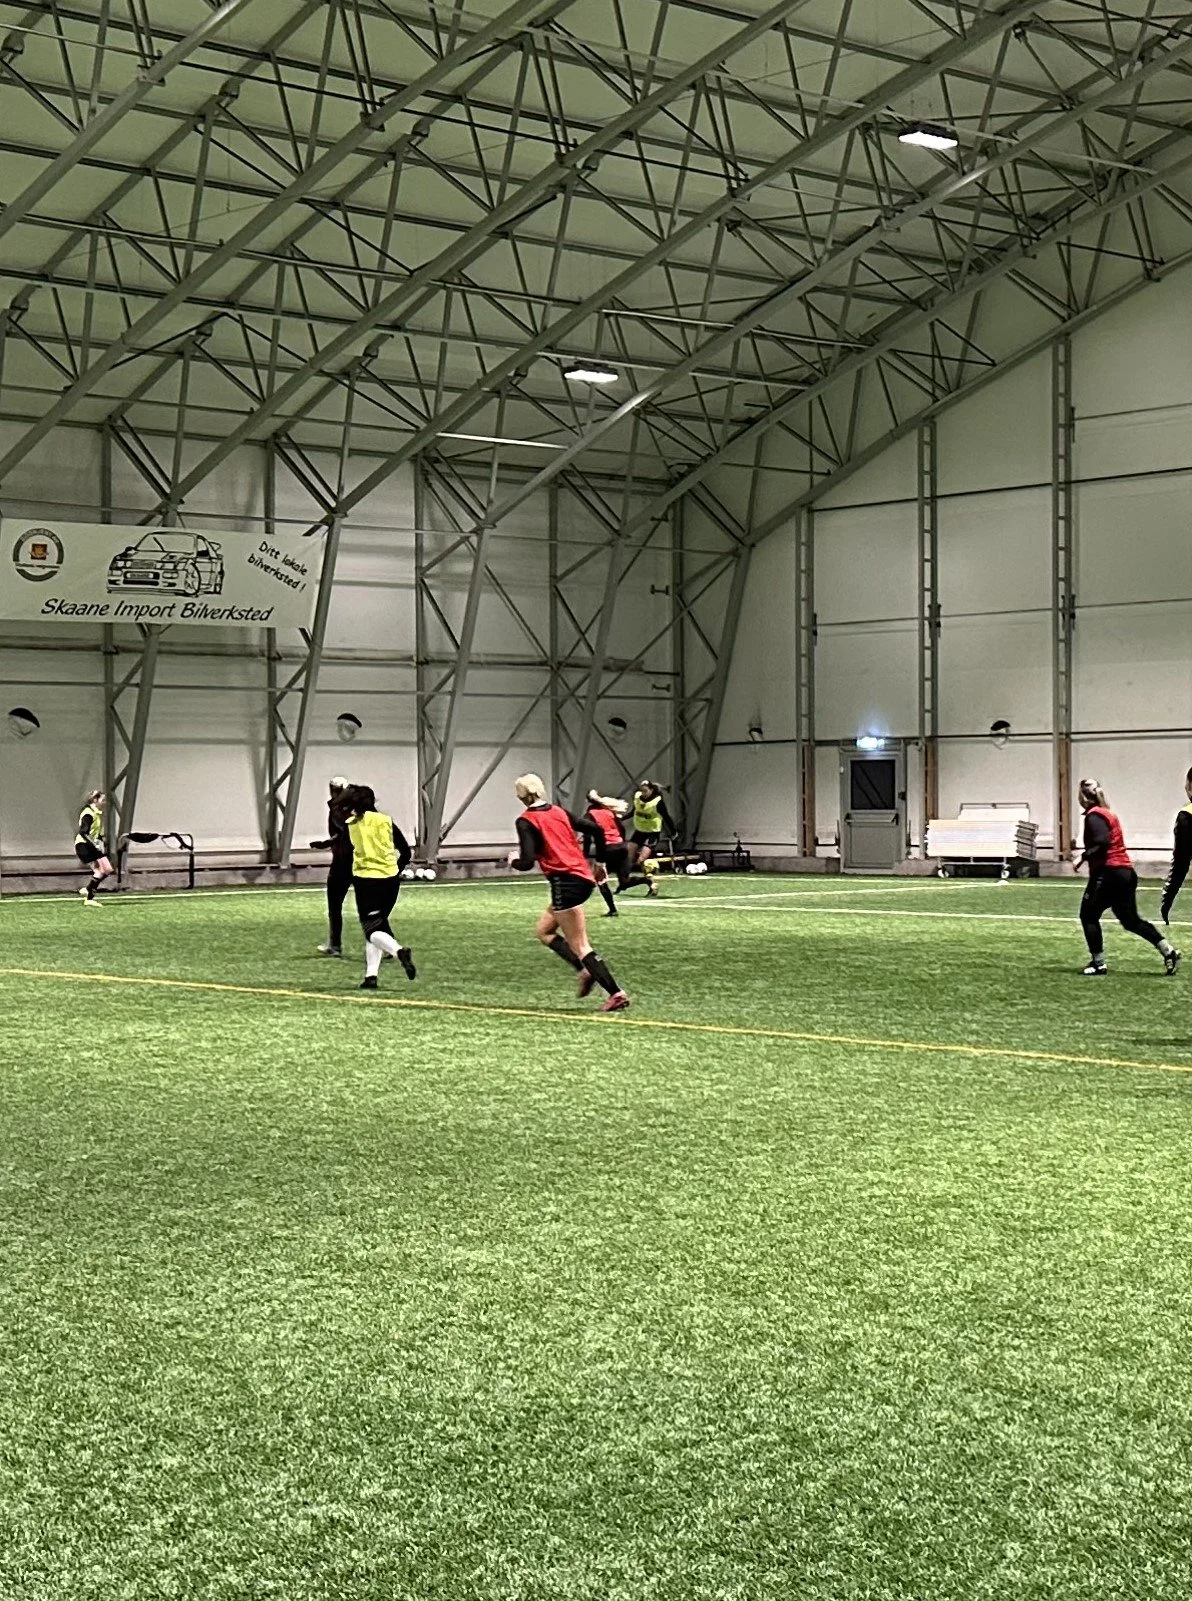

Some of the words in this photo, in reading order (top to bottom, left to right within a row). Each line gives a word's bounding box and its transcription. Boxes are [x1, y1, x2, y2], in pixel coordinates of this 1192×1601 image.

[258, 540, 280, 559] Ditt
[281, 554, 308, 576] lokale
[41, 598, 110, 616] Skaane
[114, 600, 176, 621] Import
[180, 602, 275, 621] Bilverksted
